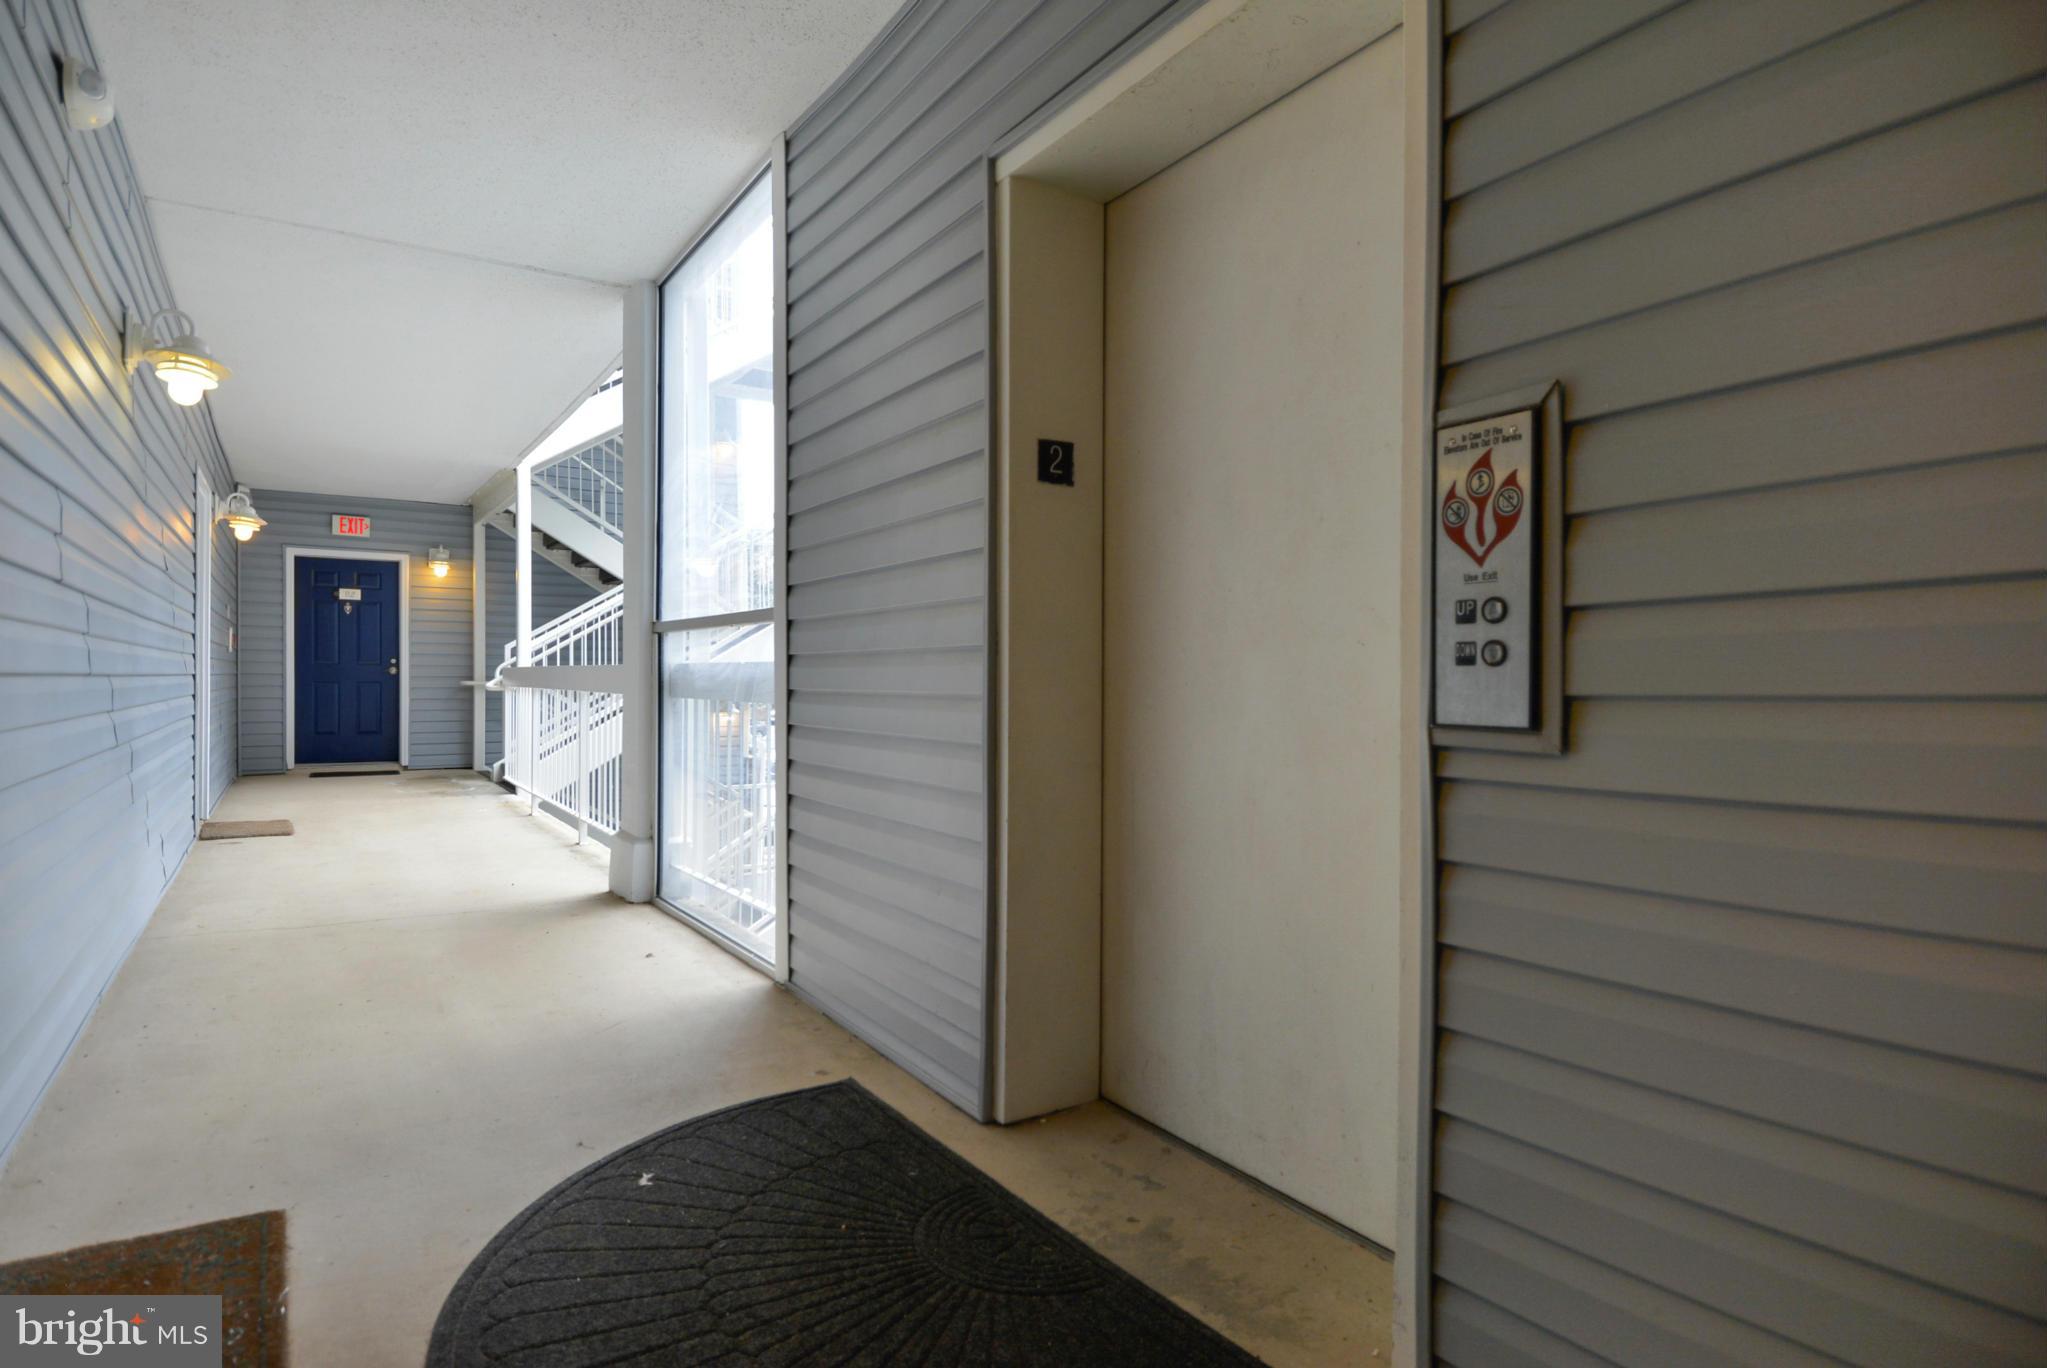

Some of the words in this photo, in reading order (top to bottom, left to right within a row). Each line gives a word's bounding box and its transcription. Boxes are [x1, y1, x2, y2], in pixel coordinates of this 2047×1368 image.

[1469, 432, 1482, 440] Case
[1484, 429, 1490, 437] Of
[1481, 439, 1490, 447] Out
[1493, 436, 1500, 445] Of
[1050, 445, 1063, 474] 2
[339, 515, 365, 537] EXIT
[1464, 573, 1479, 582] Use
[1482, 571, 1498, 581] Exit
[1457, 601, 1475, 616] UP
[1456, 643, 1476, 657] DOWN
